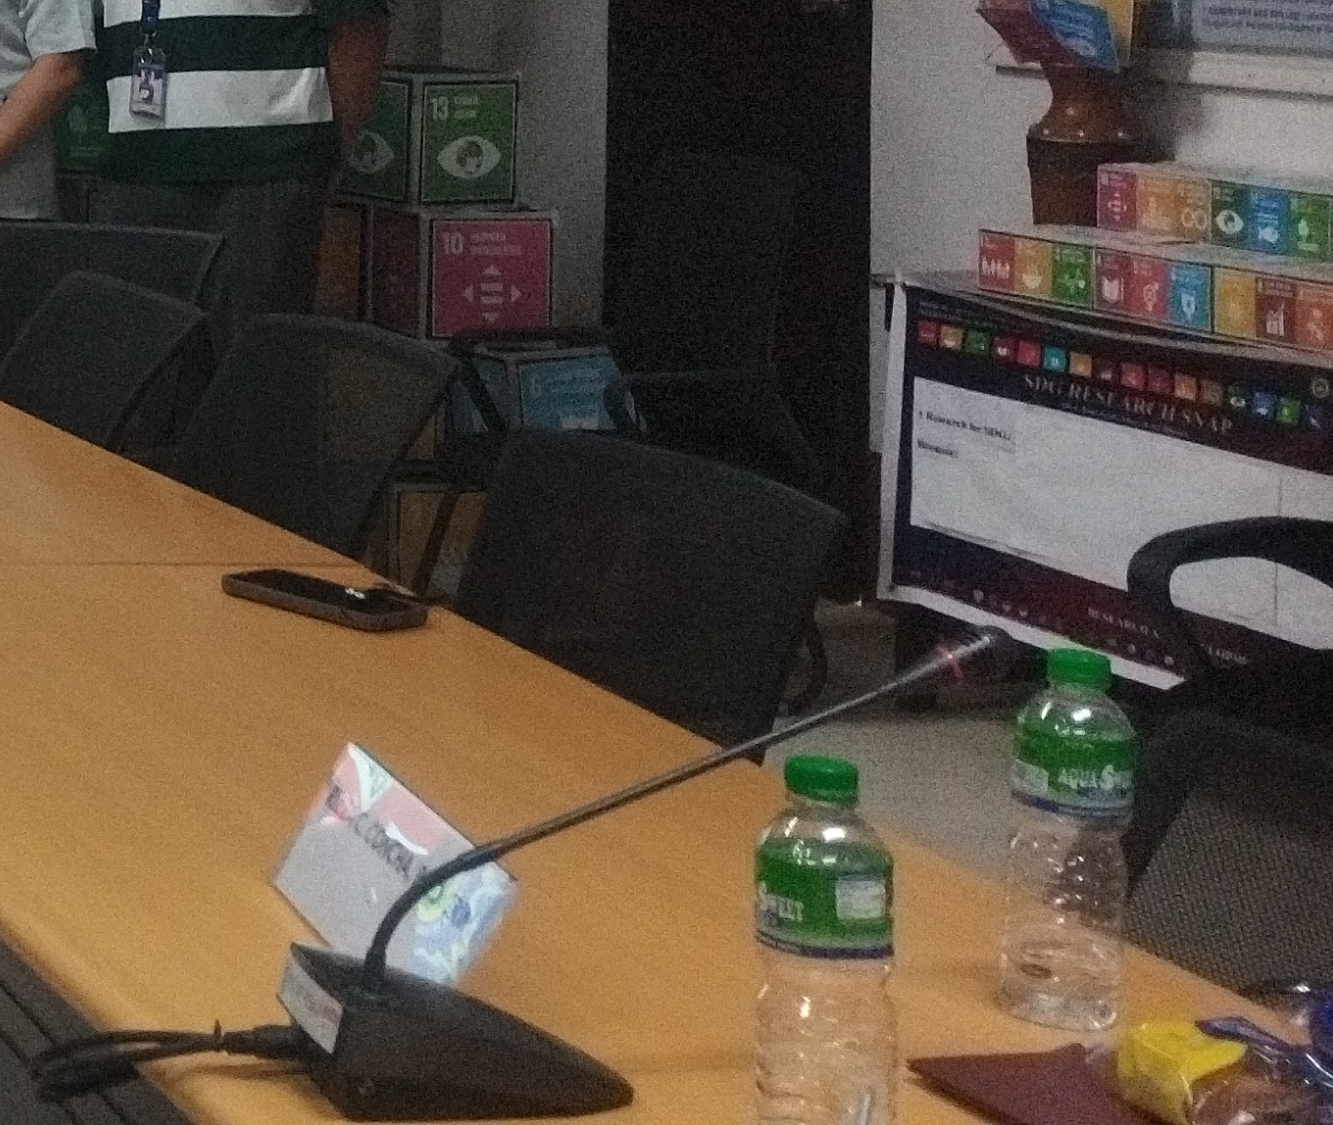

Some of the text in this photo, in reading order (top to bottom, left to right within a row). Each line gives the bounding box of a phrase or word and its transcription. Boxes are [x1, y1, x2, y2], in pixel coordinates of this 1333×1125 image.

[431, 96, 449, 120] 13
[442, 232, 464, 255] 10
[1068, 383, 1176, 422] RESEARCH
